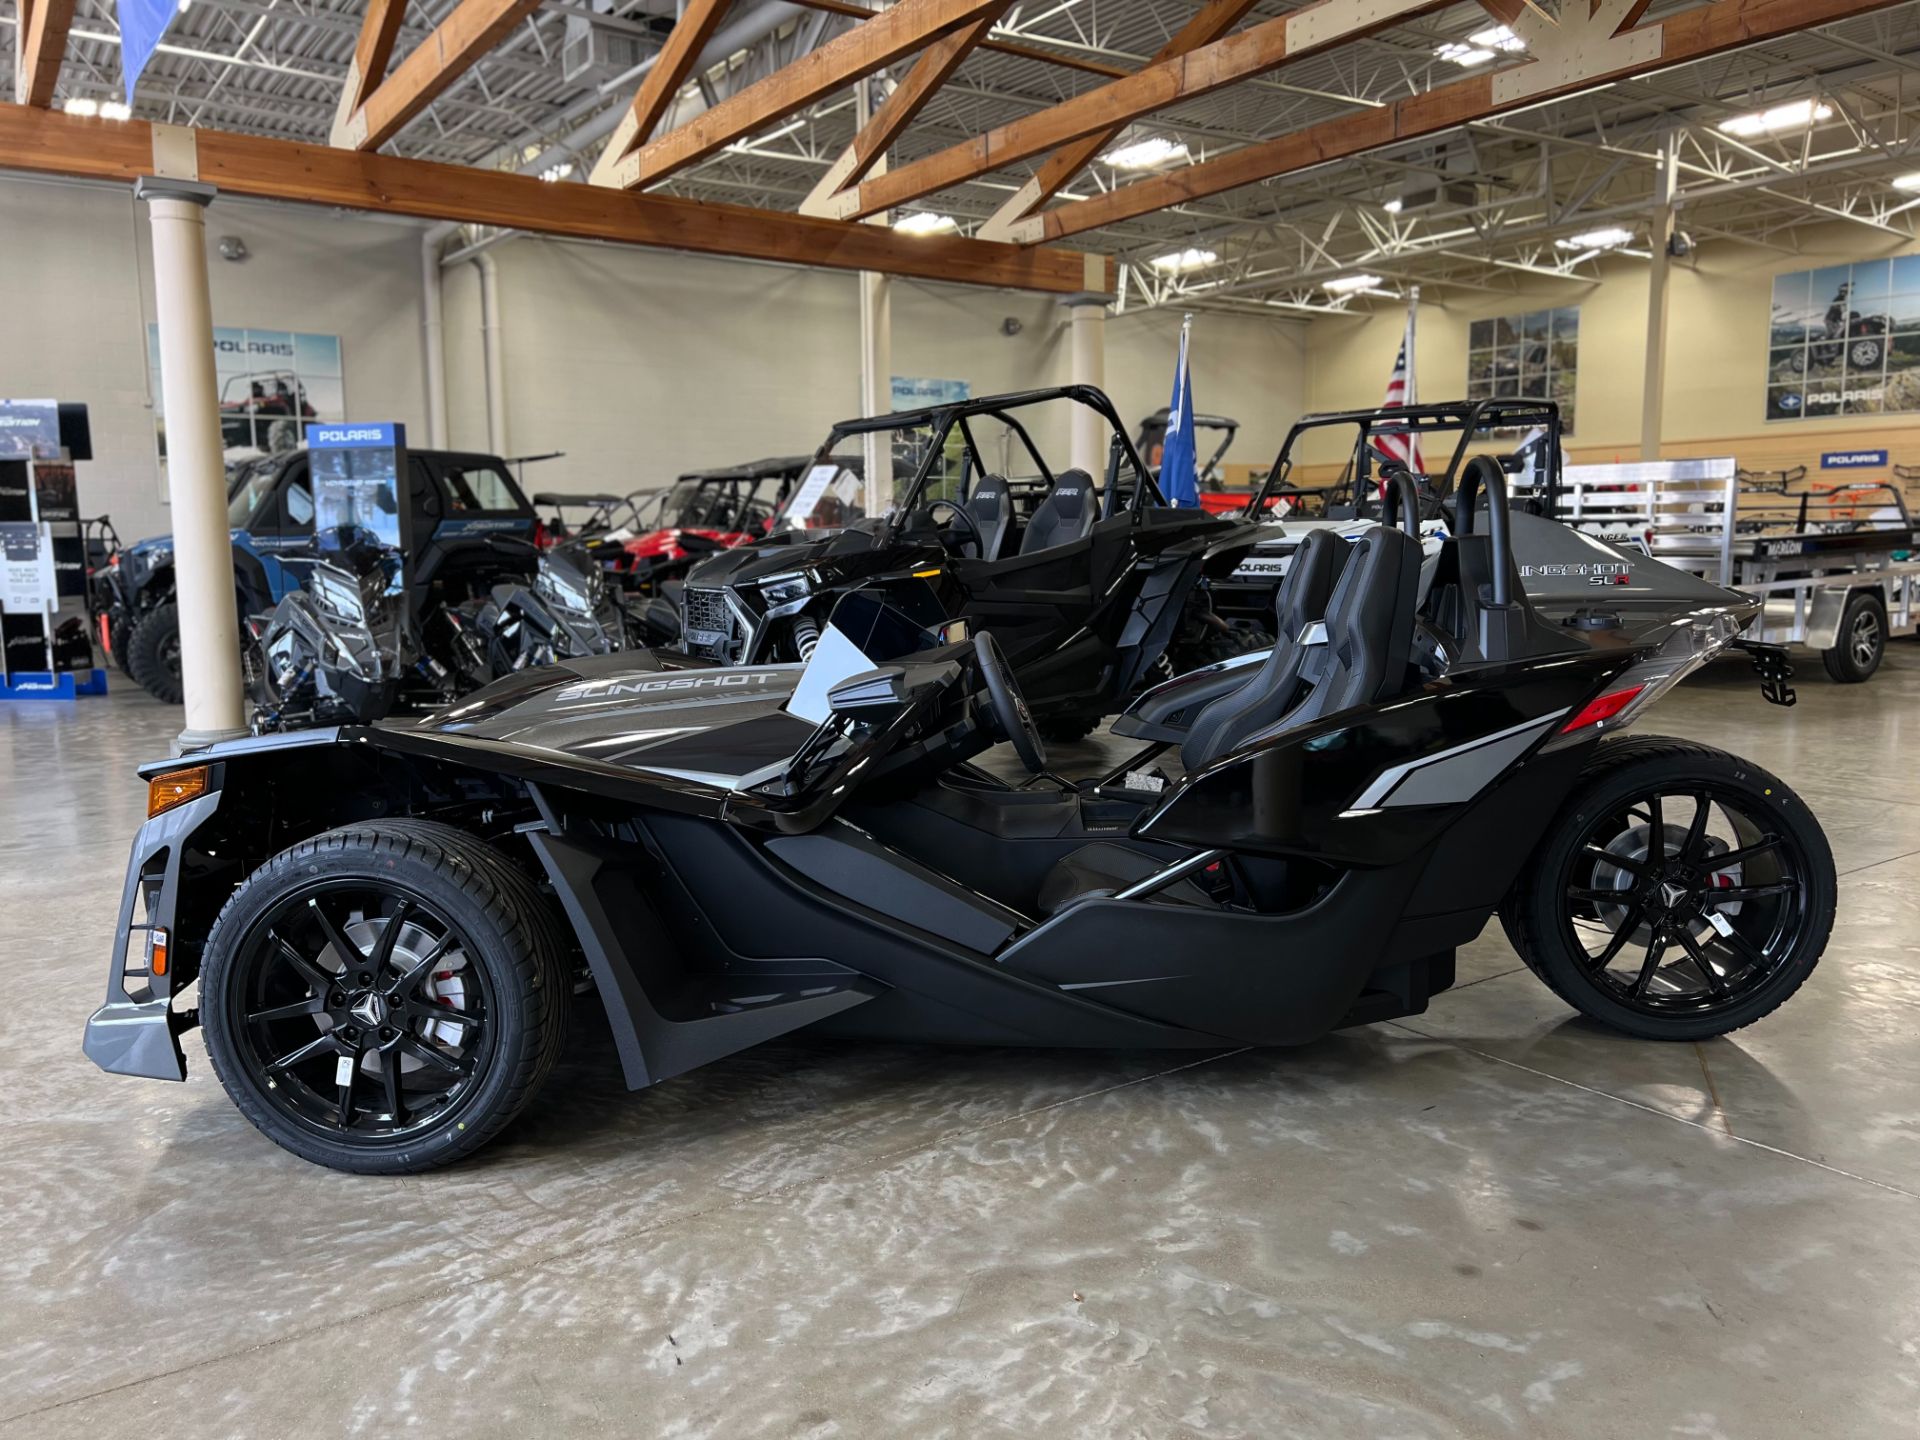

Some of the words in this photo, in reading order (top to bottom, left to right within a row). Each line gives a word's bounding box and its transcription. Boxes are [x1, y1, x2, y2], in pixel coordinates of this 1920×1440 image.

[1807, 389, 1885, 406] POLARIS
[319, 428, 382, 441] POLARIS
[1827, 454, 1880, 464] POLARIS
[1239, 564, 1282, 572] OLARIS
[1589, 575, 1630, 585] SLR
[555, 673, 778, 702] SLINGSHOT
